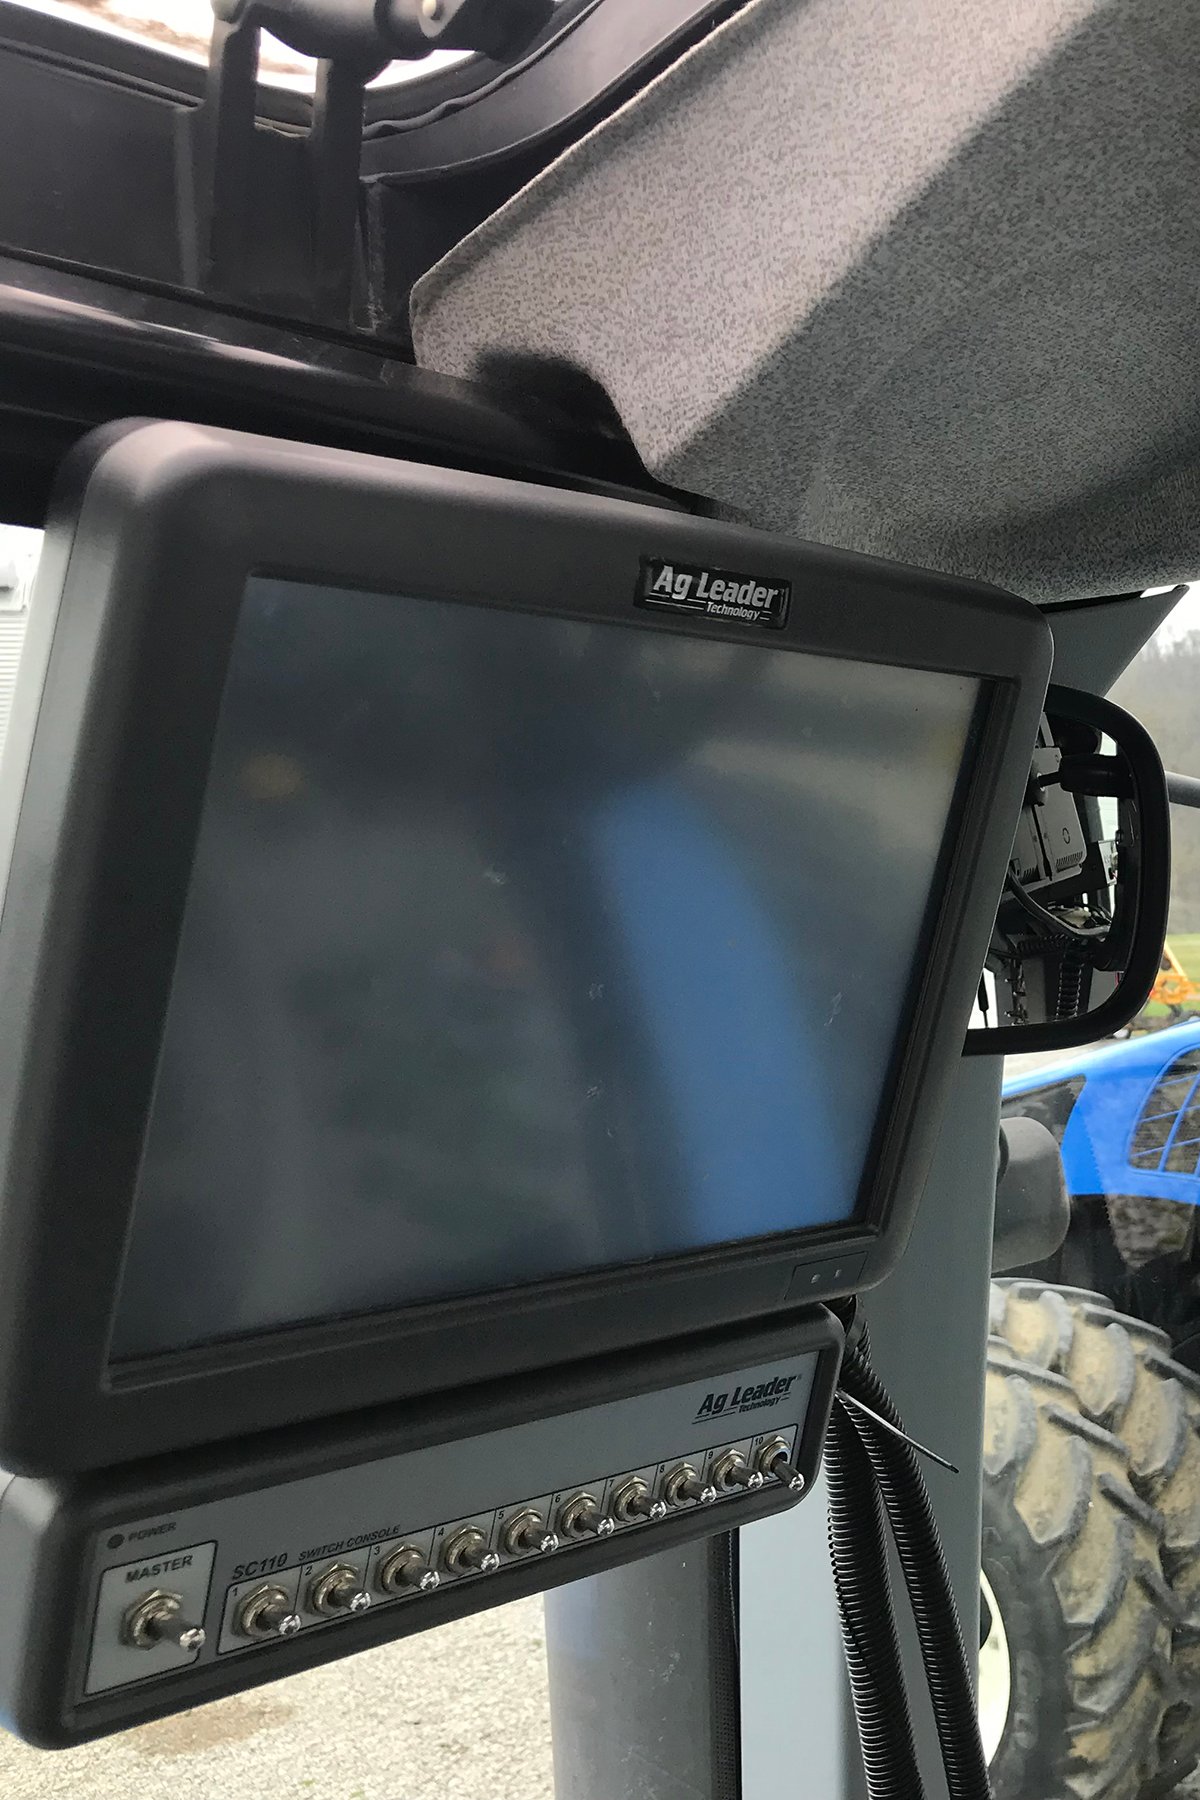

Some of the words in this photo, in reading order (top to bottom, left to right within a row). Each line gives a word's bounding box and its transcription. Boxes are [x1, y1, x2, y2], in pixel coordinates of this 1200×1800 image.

[653, 565, 693, 600] Ag
[696, 572, 779, 609] Leader
[706, 601, 761, 622] Technology
[697, 1393, 728, 1415] Ag
[730, 1376, 797, 1407] Leader
[738, 1396, 781, 1414] Technology
[754, 1436, 763, 1446] 10
[708, 1450, 714, 1460] 9
[659, 1463, 665, 1474] 8
[609, 1478, 615, 1488] 7
[554, 1492, 561, 1503] 6
[498, 1510, 505, 1520] 5
[128, 1522, 177, 1541] POWER
[437, 1527, 445, 1537] 4
[231, 1553, 288, 1581] SC110
[298, 1539, 345, 1562] SWITCH
[345, 1524, 401, 1548] CONSOLE
[374, 1545, 381, 1556] 3
[125, 1555, 194, 1584] MASTER
[304, 1565, 314, 1576] 2
[232, 1586, 239, 1597] 1
